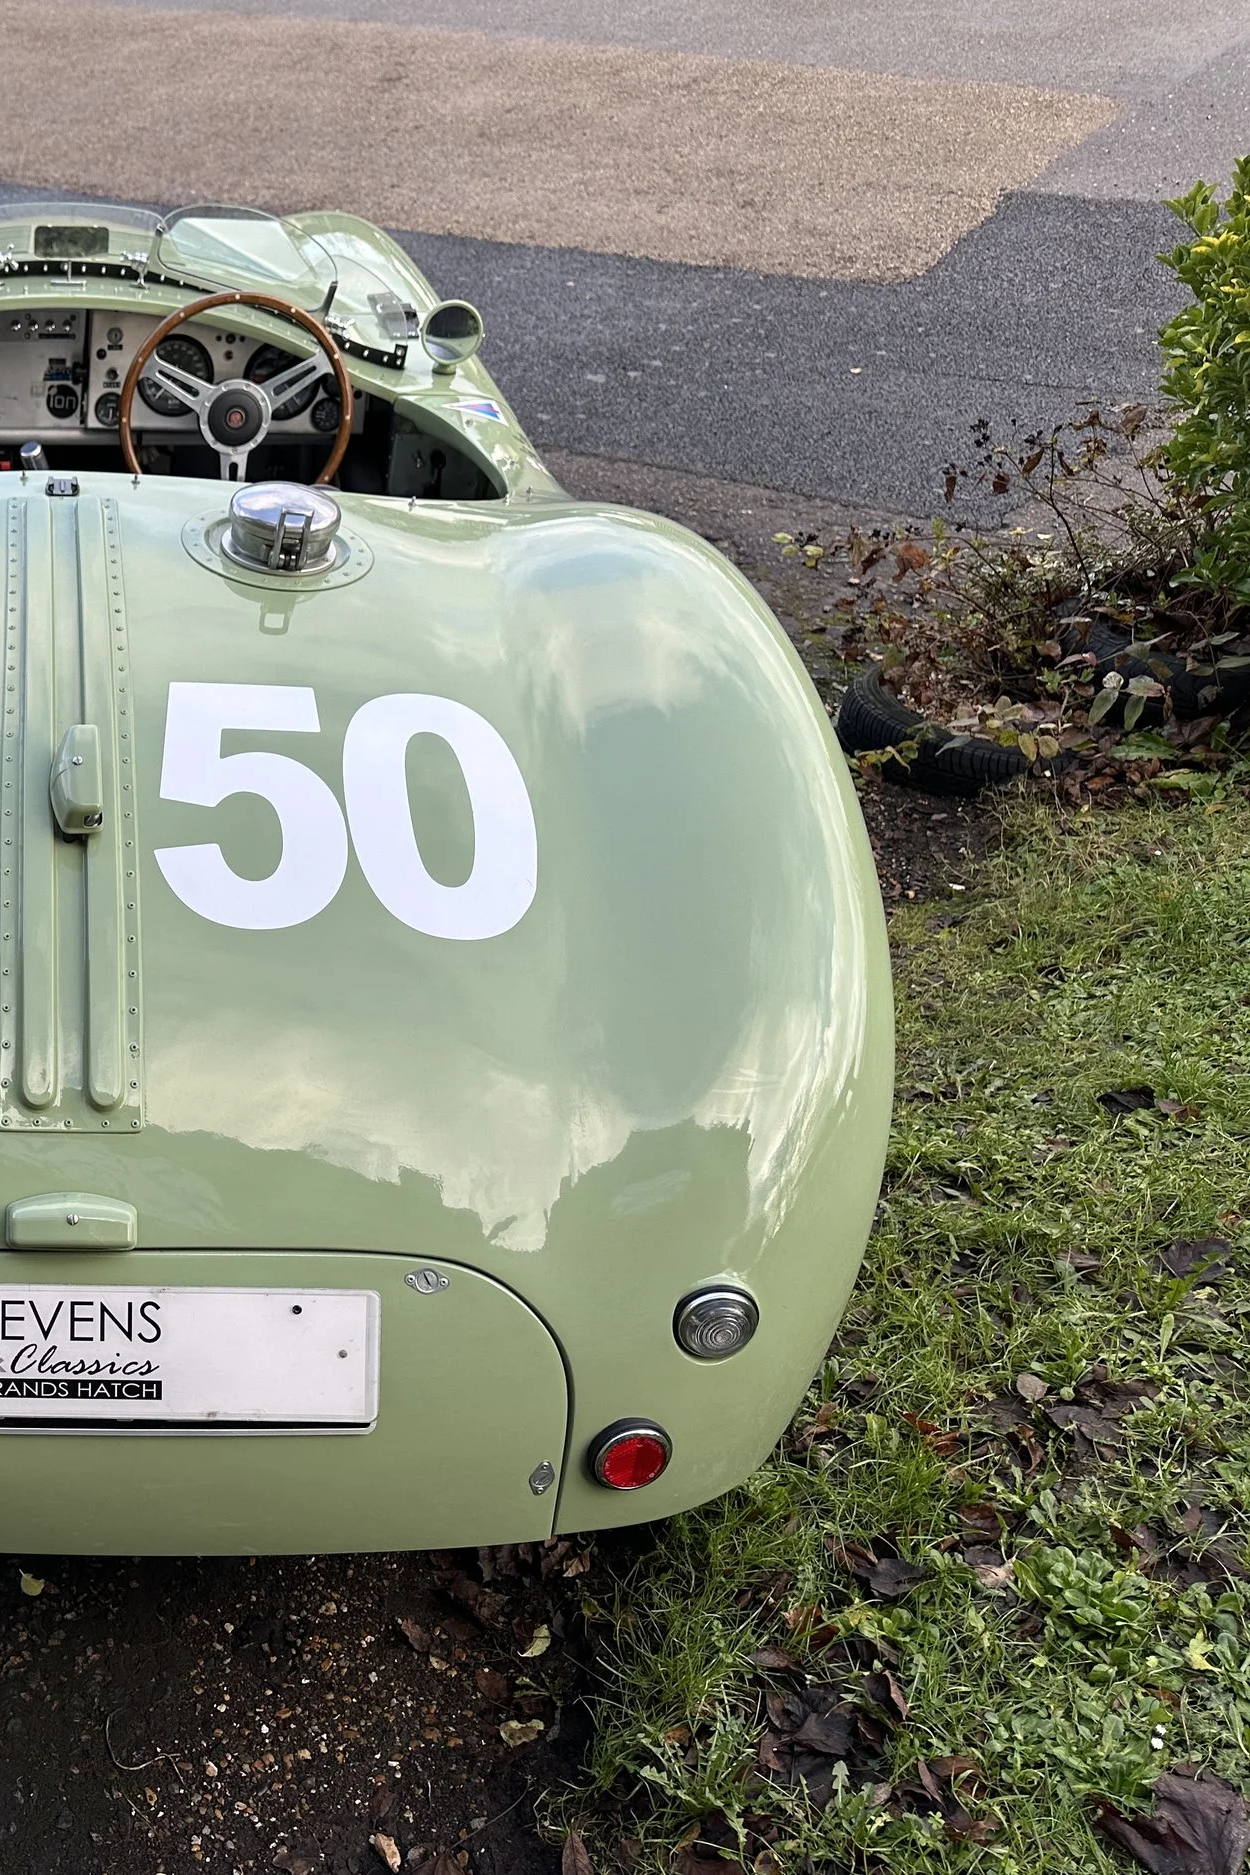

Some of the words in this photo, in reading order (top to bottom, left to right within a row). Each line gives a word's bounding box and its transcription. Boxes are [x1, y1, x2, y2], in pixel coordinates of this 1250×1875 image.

[48, 386, 77, 410] ion
[153, 681, 538, 941] 50
[10, 1343, 160, 1376] Classics
[77, 1382, 157, 1398] HATCH
